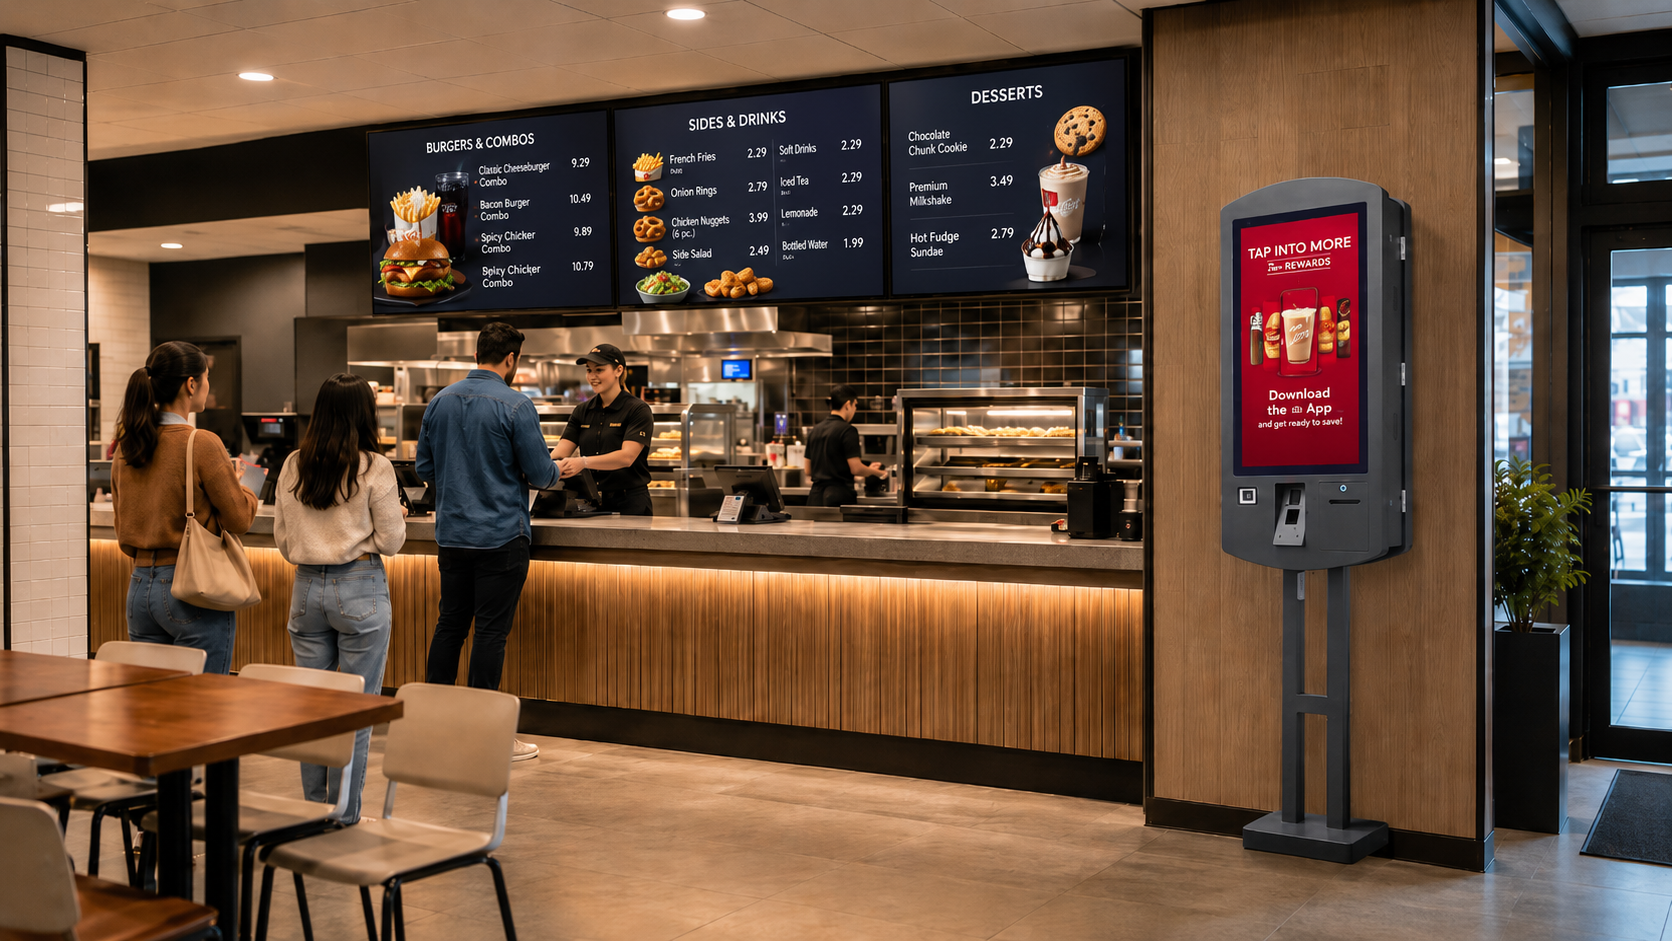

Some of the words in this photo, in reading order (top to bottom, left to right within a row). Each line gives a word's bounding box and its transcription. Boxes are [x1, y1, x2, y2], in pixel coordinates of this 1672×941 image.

[971, 85, 1043, 104] DESSERTS
[689, 116, 724, 131] SIDES
[727, 115, 736, 128] &
[739, 111, 786, 127] DRINKS
[908, 130, 950, 142] Chocolate
[426, 138, 473, 154] BURGERS
[475, 137, 483, 149] &
[486, 133, 535, 147] COMBOS
[779, 145, 794, 155] Soft
[795, 143, 817, 154] Drinks
[841, 139, 862, 150] 2.29
[908, 143, 936, 156] Chunk
[938, 142, 968, 154] Cookie
[989, 137, 1013, 150] 2.29
[669, 153, 696, 164] French
[697, 152, 716, 162] Fries
[747, 147, 767, 158] 2.29
[571, 157, 590, 168] 9.29
[479, 177, 507, 187] Combo
[796, 175, 809, 186] Tea
[842, 171, 862, 183] 2.29
[990, 175, 1013, 187] 3.49
[671, 188, 694, 198] Onion
[696, 186, 717, 197] Rings
[748, 181, 768, 192] 2.79
[909, 181, 948, 193] Premium
[480, 200, 503, 210] Bacon
[505, 198, 530, 209] Burger
[570, 193, 591, 204] 10.49
[909, 195, 952, 206] Milkshake
[781, 207, 818, 219] Lemonade
[842, 204, 863, 216] 2.29
[481, 211, 509, 221] Combo
[700, 215, 730, 227] Nuggets
[749, 212, 768, 223] 3.99
[573, 226, 592, 237] 9.89
[672, 229, 679, 239] (6
[681, 228, 696, 239] pc.)
[991, 228, 1014, 239] 2.79
[481, 232, 502, 243] Spicy
[844, 237, 864, 248] 1.99
[910, 233, 927, 244] Hot
[930, 231, 960, 244] Fudge
[481, 244, 511, 254] Combo
[808, 239, 828, 249] Water
[1247, 246, 1271, 259] TAP
[1275, 242, 1306, 256] INTO
[1310, 236, 1351, 252] MORE
[672, 250, 689, 259] Side
[691, 248, 712, 258] Salad
[749, 245, 769, 256] 2.49
[910, 247, 943, 258] Sundae
[572, 261, 594, 272] 10.79
[1285, 257, 1331, 270] REWARDS
[483, 278, 513, 288] Combo
[1269, 387, 1330, 401] Download
[1267, 404, 1287, 415] the
[1306, 403, 1332, 416] App
[1258, 420, 1272, 428] and
[1274, 421, 1287, 429] get
[1288, 419, 1310, 428] ready
[1322, 417, 1343, 426] save!
